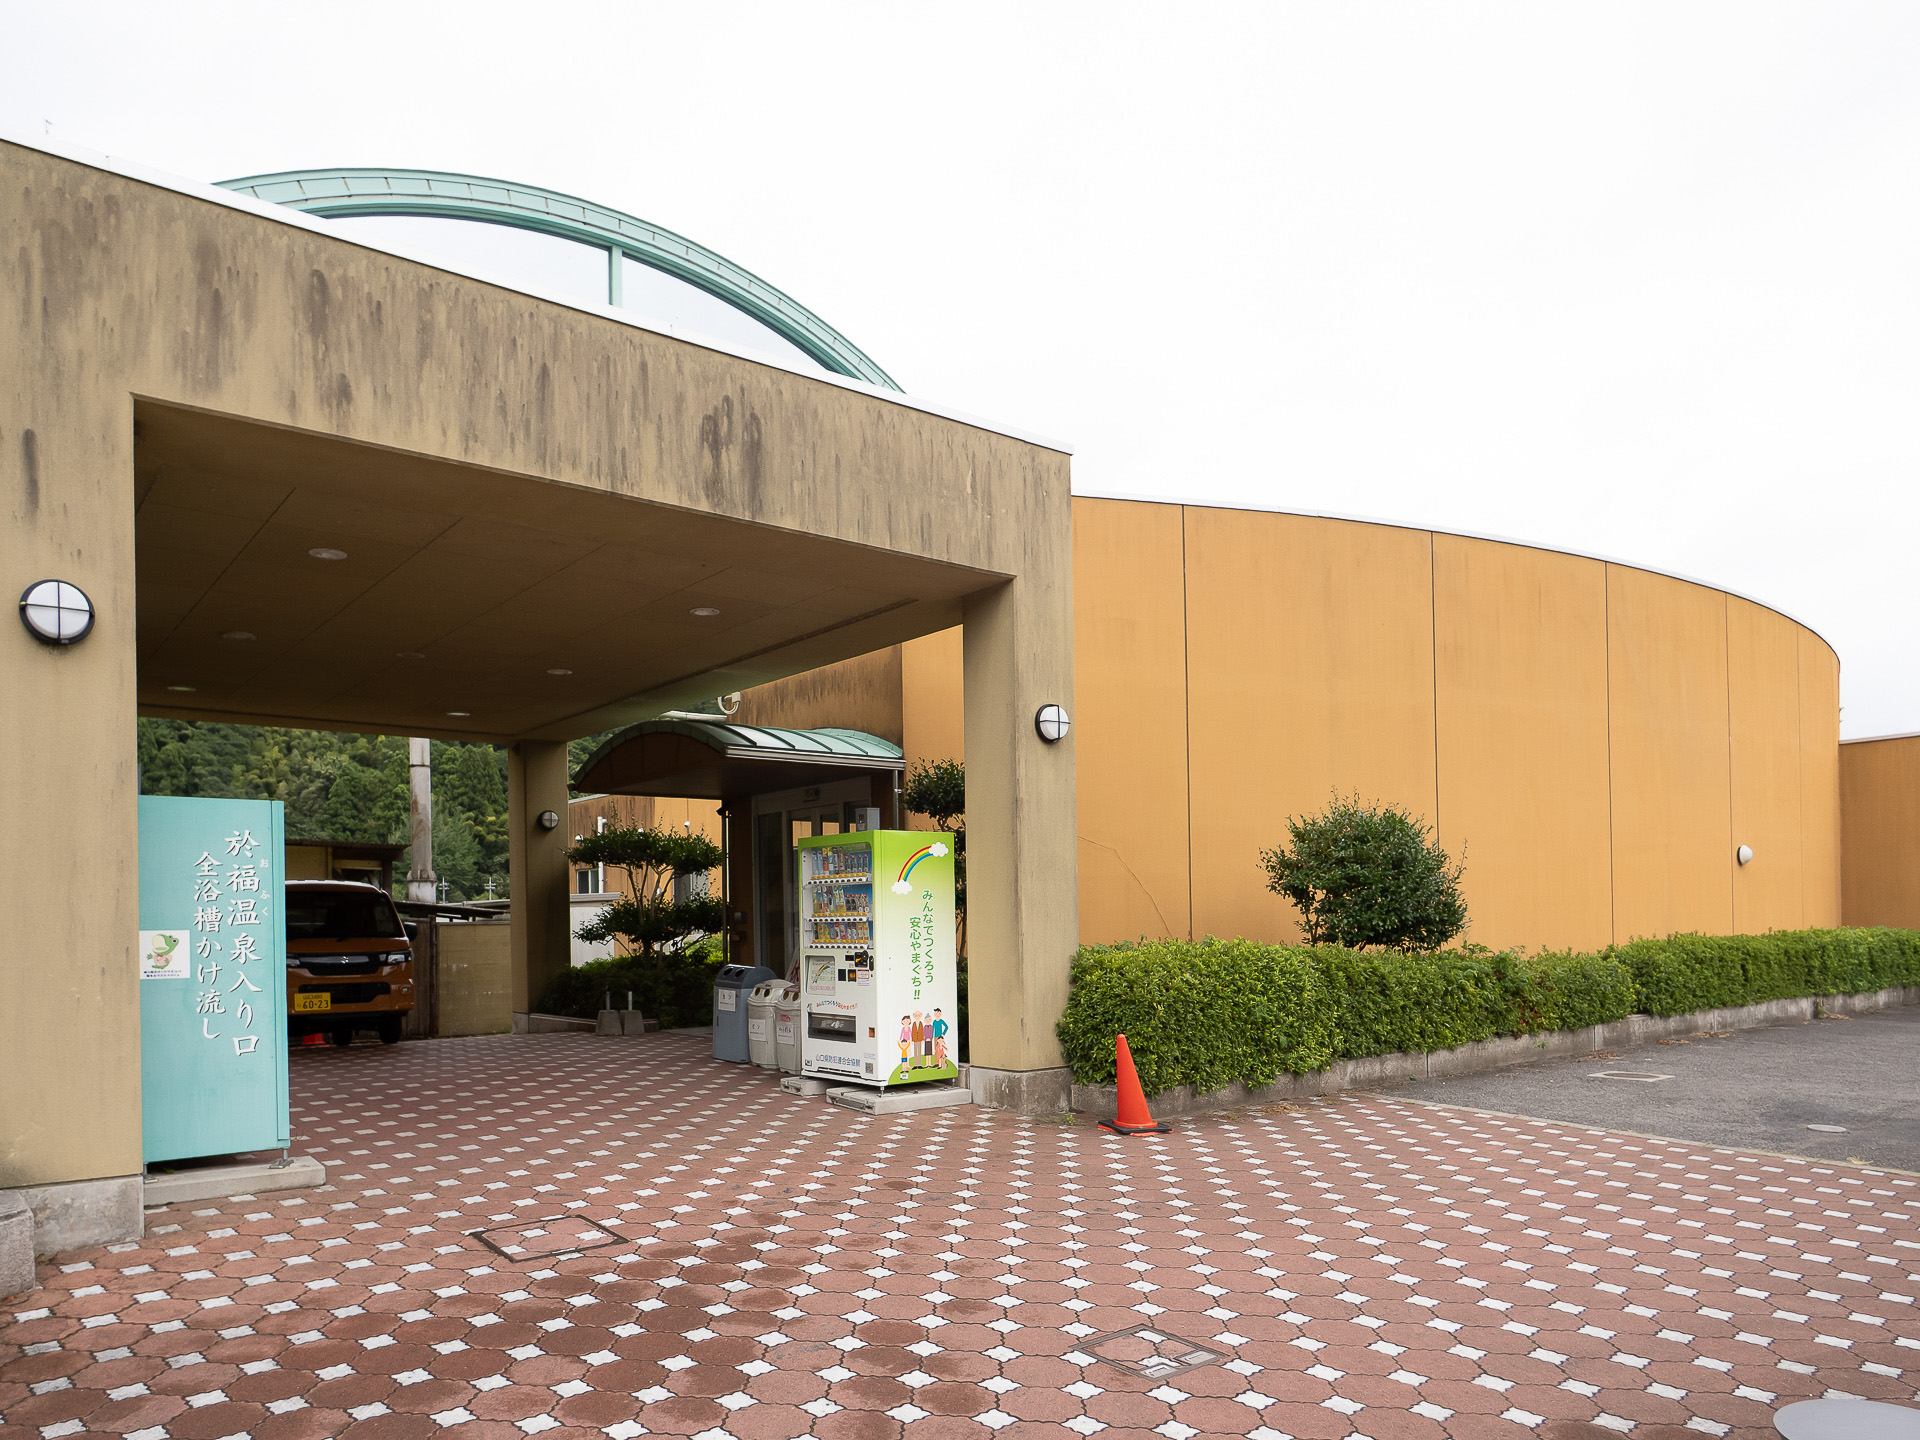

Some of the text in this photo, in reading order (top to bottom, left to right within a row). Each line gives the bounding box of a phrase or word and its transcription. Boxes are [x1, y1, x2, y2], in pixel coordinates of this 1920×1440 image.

[193, 851, 226, 1040] 全浴槽かけ流し
[225, 830, 263, 1056] 於福温泉入り口
[259, 858, 270, 916] おふく
[922, 889, 934, 984] みんなでつくろう
